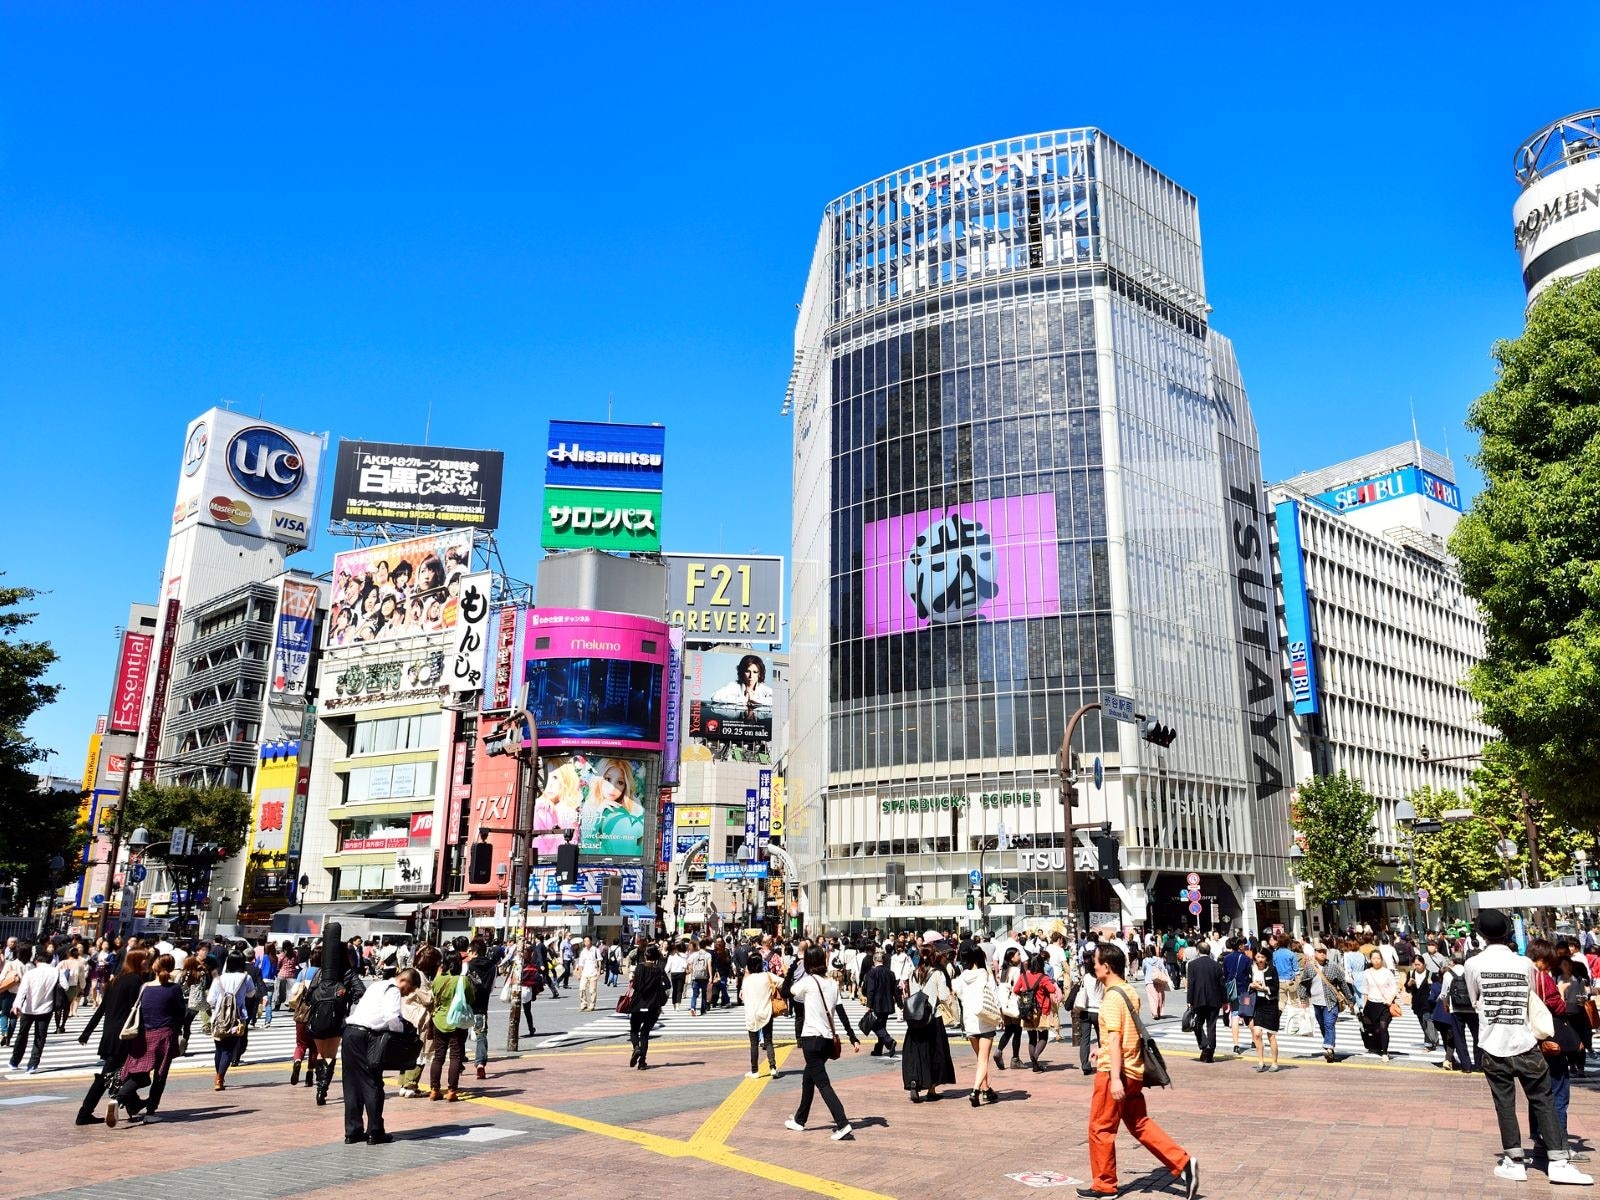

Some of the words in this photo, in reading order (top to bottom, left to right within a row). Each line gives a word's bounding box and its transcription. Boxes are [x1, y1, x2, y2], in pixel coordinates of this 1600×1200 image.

[547, 442, 662, 466] Hisamitsu
[1335, 474, 1405, 510] SEIBU
[1423, 475, 1458, 508] SEIBU
[209, 502, 251, 519] MasterCard
[548, 505, 655, 531] サロンパス
[275, 517, 305, 533] VISA
[686, 563, 751, 607] F21
[454, 585, 488, 687] もんじゃ
[672, 610, 751, 634] OREVER
[756, 612, 776, 635] 21
[1229, 482, 1283, 801] TSUTAYA
[114, 635, 145, 727] Essential
[282, 663, 299, 675] まで
[1289, 640, 1311, 706] SEIBU
[287, 680, 305, 691] 地下
[666, 700, 677, 742] neon
[722, 727, 743, 737] 09.25
[745, 729, 754, 737] on
[754, 729, 769, 738] sale
[260, 800, 285, 831] 薬
[760, 773, 770, 832] 洋服の青山
[882, 795, 972, 813] STARBUCKS
[980, 791, 1042, 806] COFFEE
[412, 814, 433, 832] JTB
